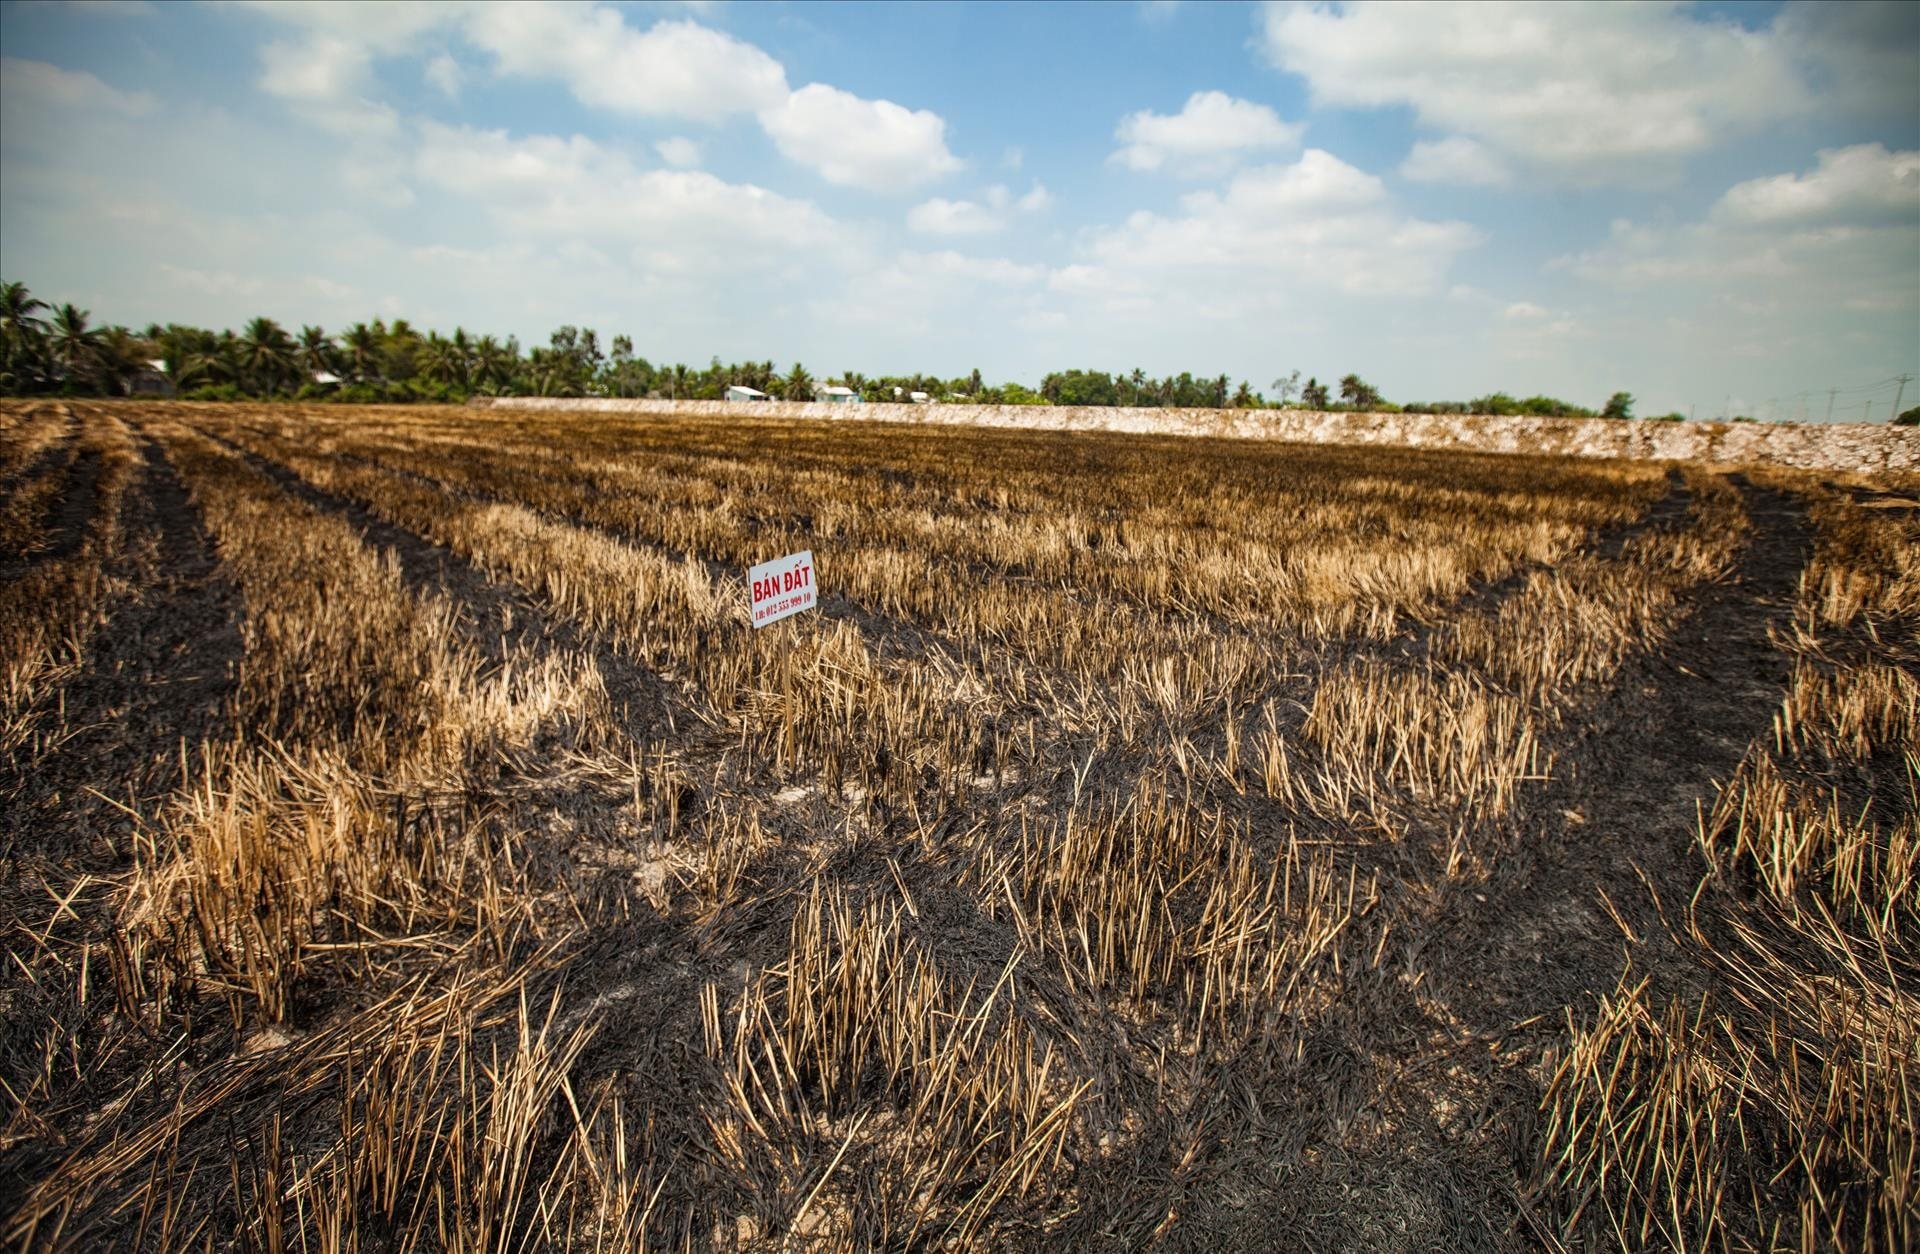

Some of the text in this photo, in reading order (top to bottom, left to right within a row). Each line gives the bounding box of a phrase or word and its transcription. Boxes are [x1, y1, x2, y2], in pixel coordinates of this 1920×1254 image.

[753, 560, 809, 603] BÁN ĐẤT
[766, 603, 777, 617] 012
[804, 592, 811, 603] 10
